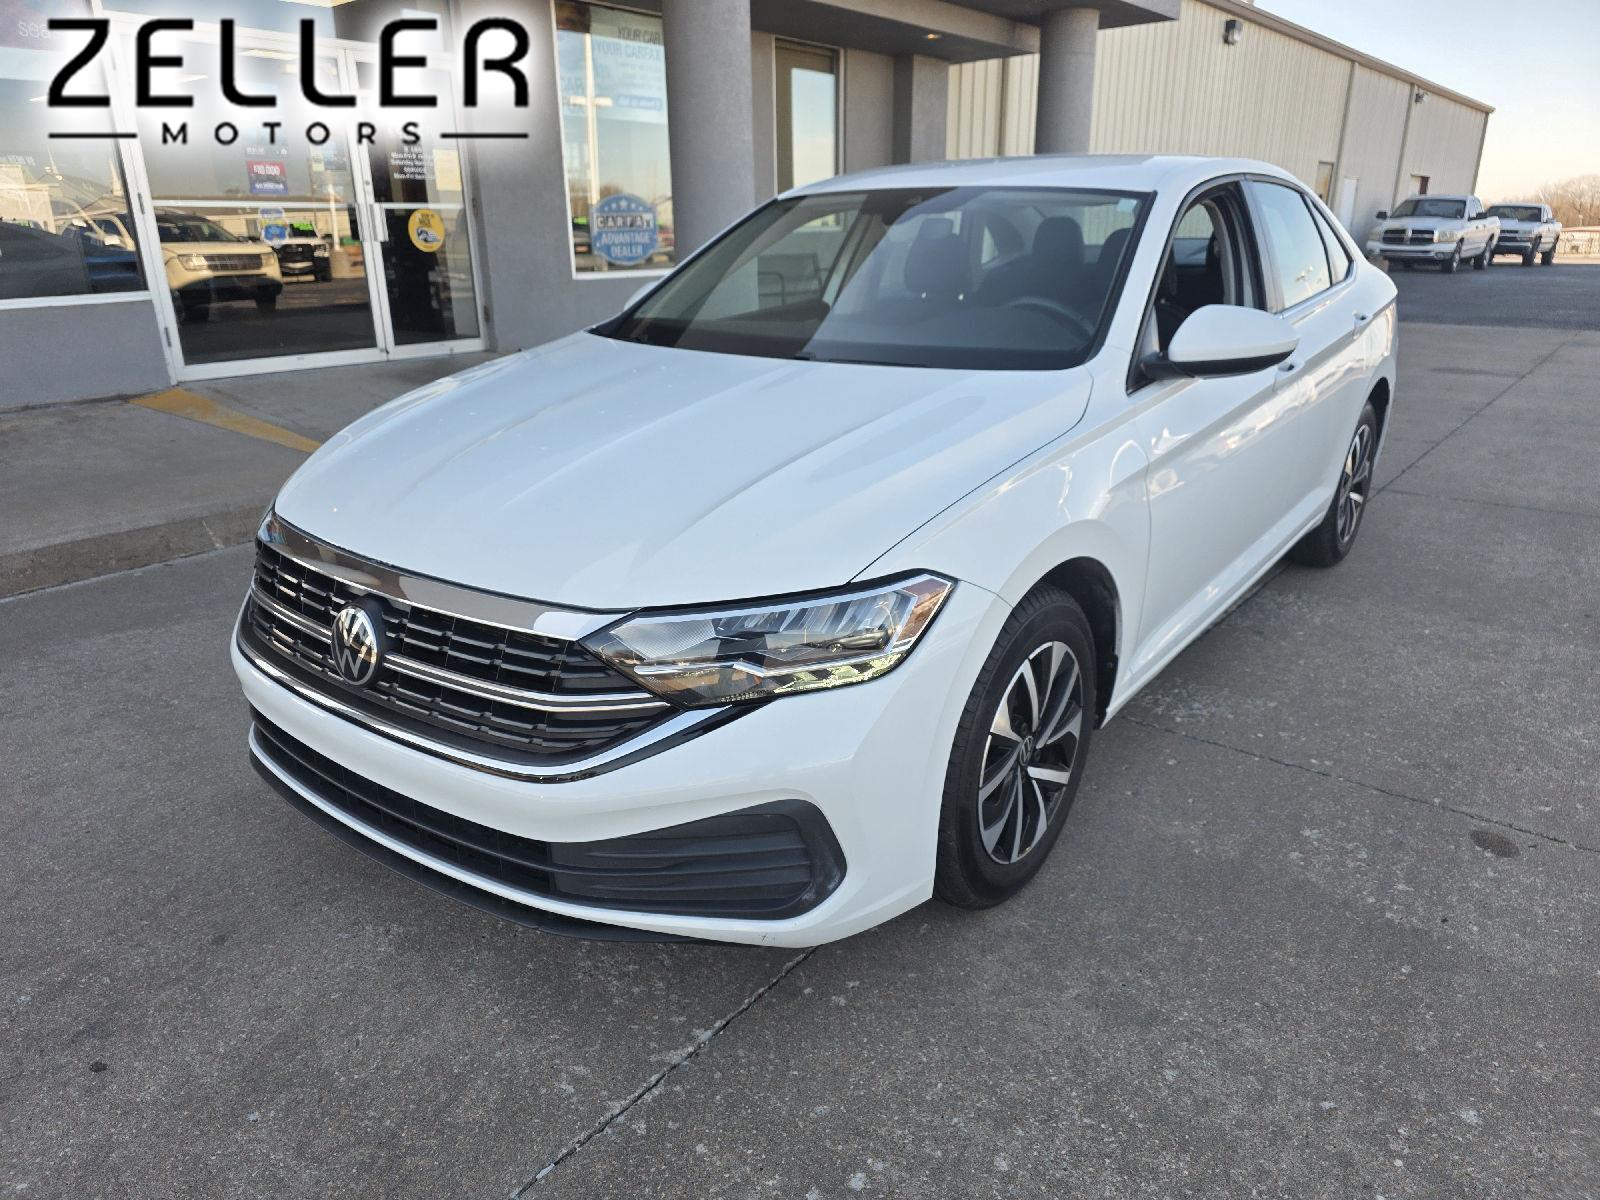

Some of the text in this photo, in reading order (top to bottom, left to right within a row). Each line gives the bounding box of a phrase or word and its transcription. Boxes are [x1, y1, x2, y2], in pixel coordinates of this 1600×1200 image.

[595, 214, 653, 230] CARFAX
[600, 231, 651, 245] ADVANTAGE
[610, 244, 643, 257] DEALER
